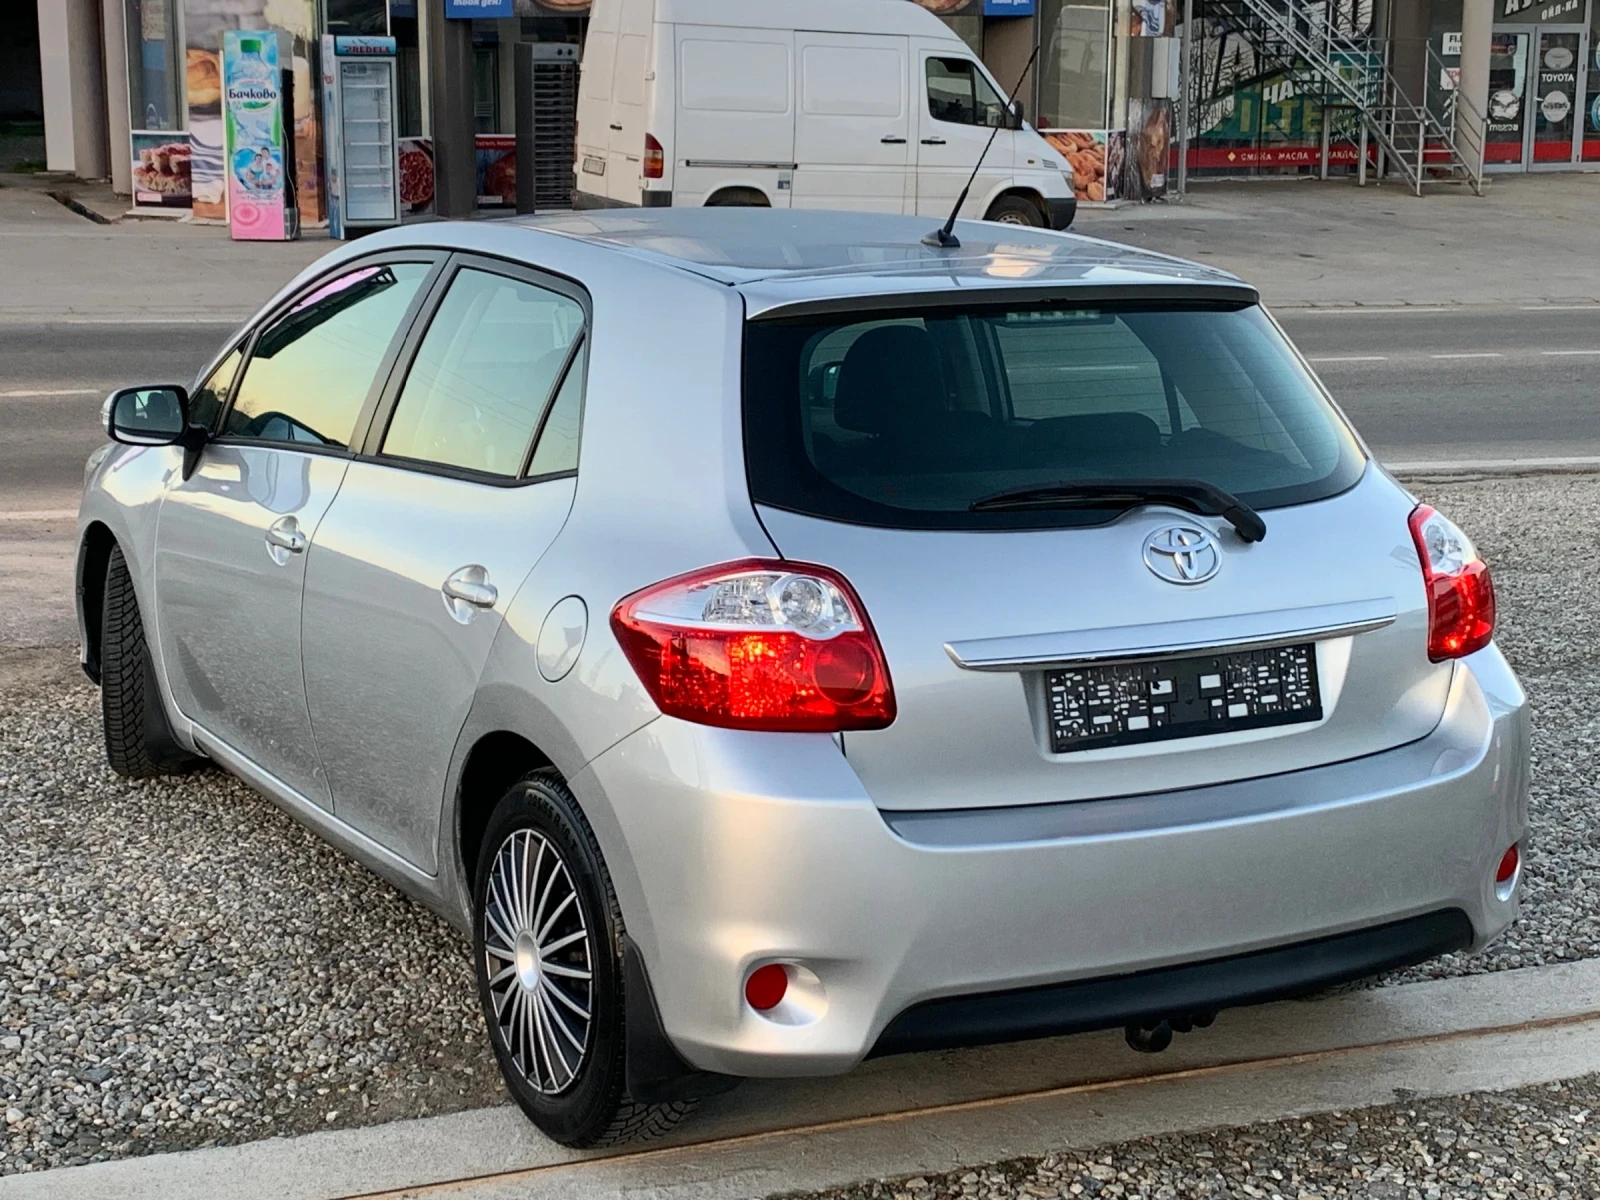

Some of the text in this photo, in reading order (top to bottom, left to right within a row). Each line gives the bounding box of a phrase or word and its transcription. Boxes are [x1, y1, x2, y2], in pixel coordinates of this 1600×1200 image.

[1541, 73, 1575, 82] TOYOTA
[229, 88, 277, 99] Бачково
[1278, 152, 1309, 160] МАСЛА
